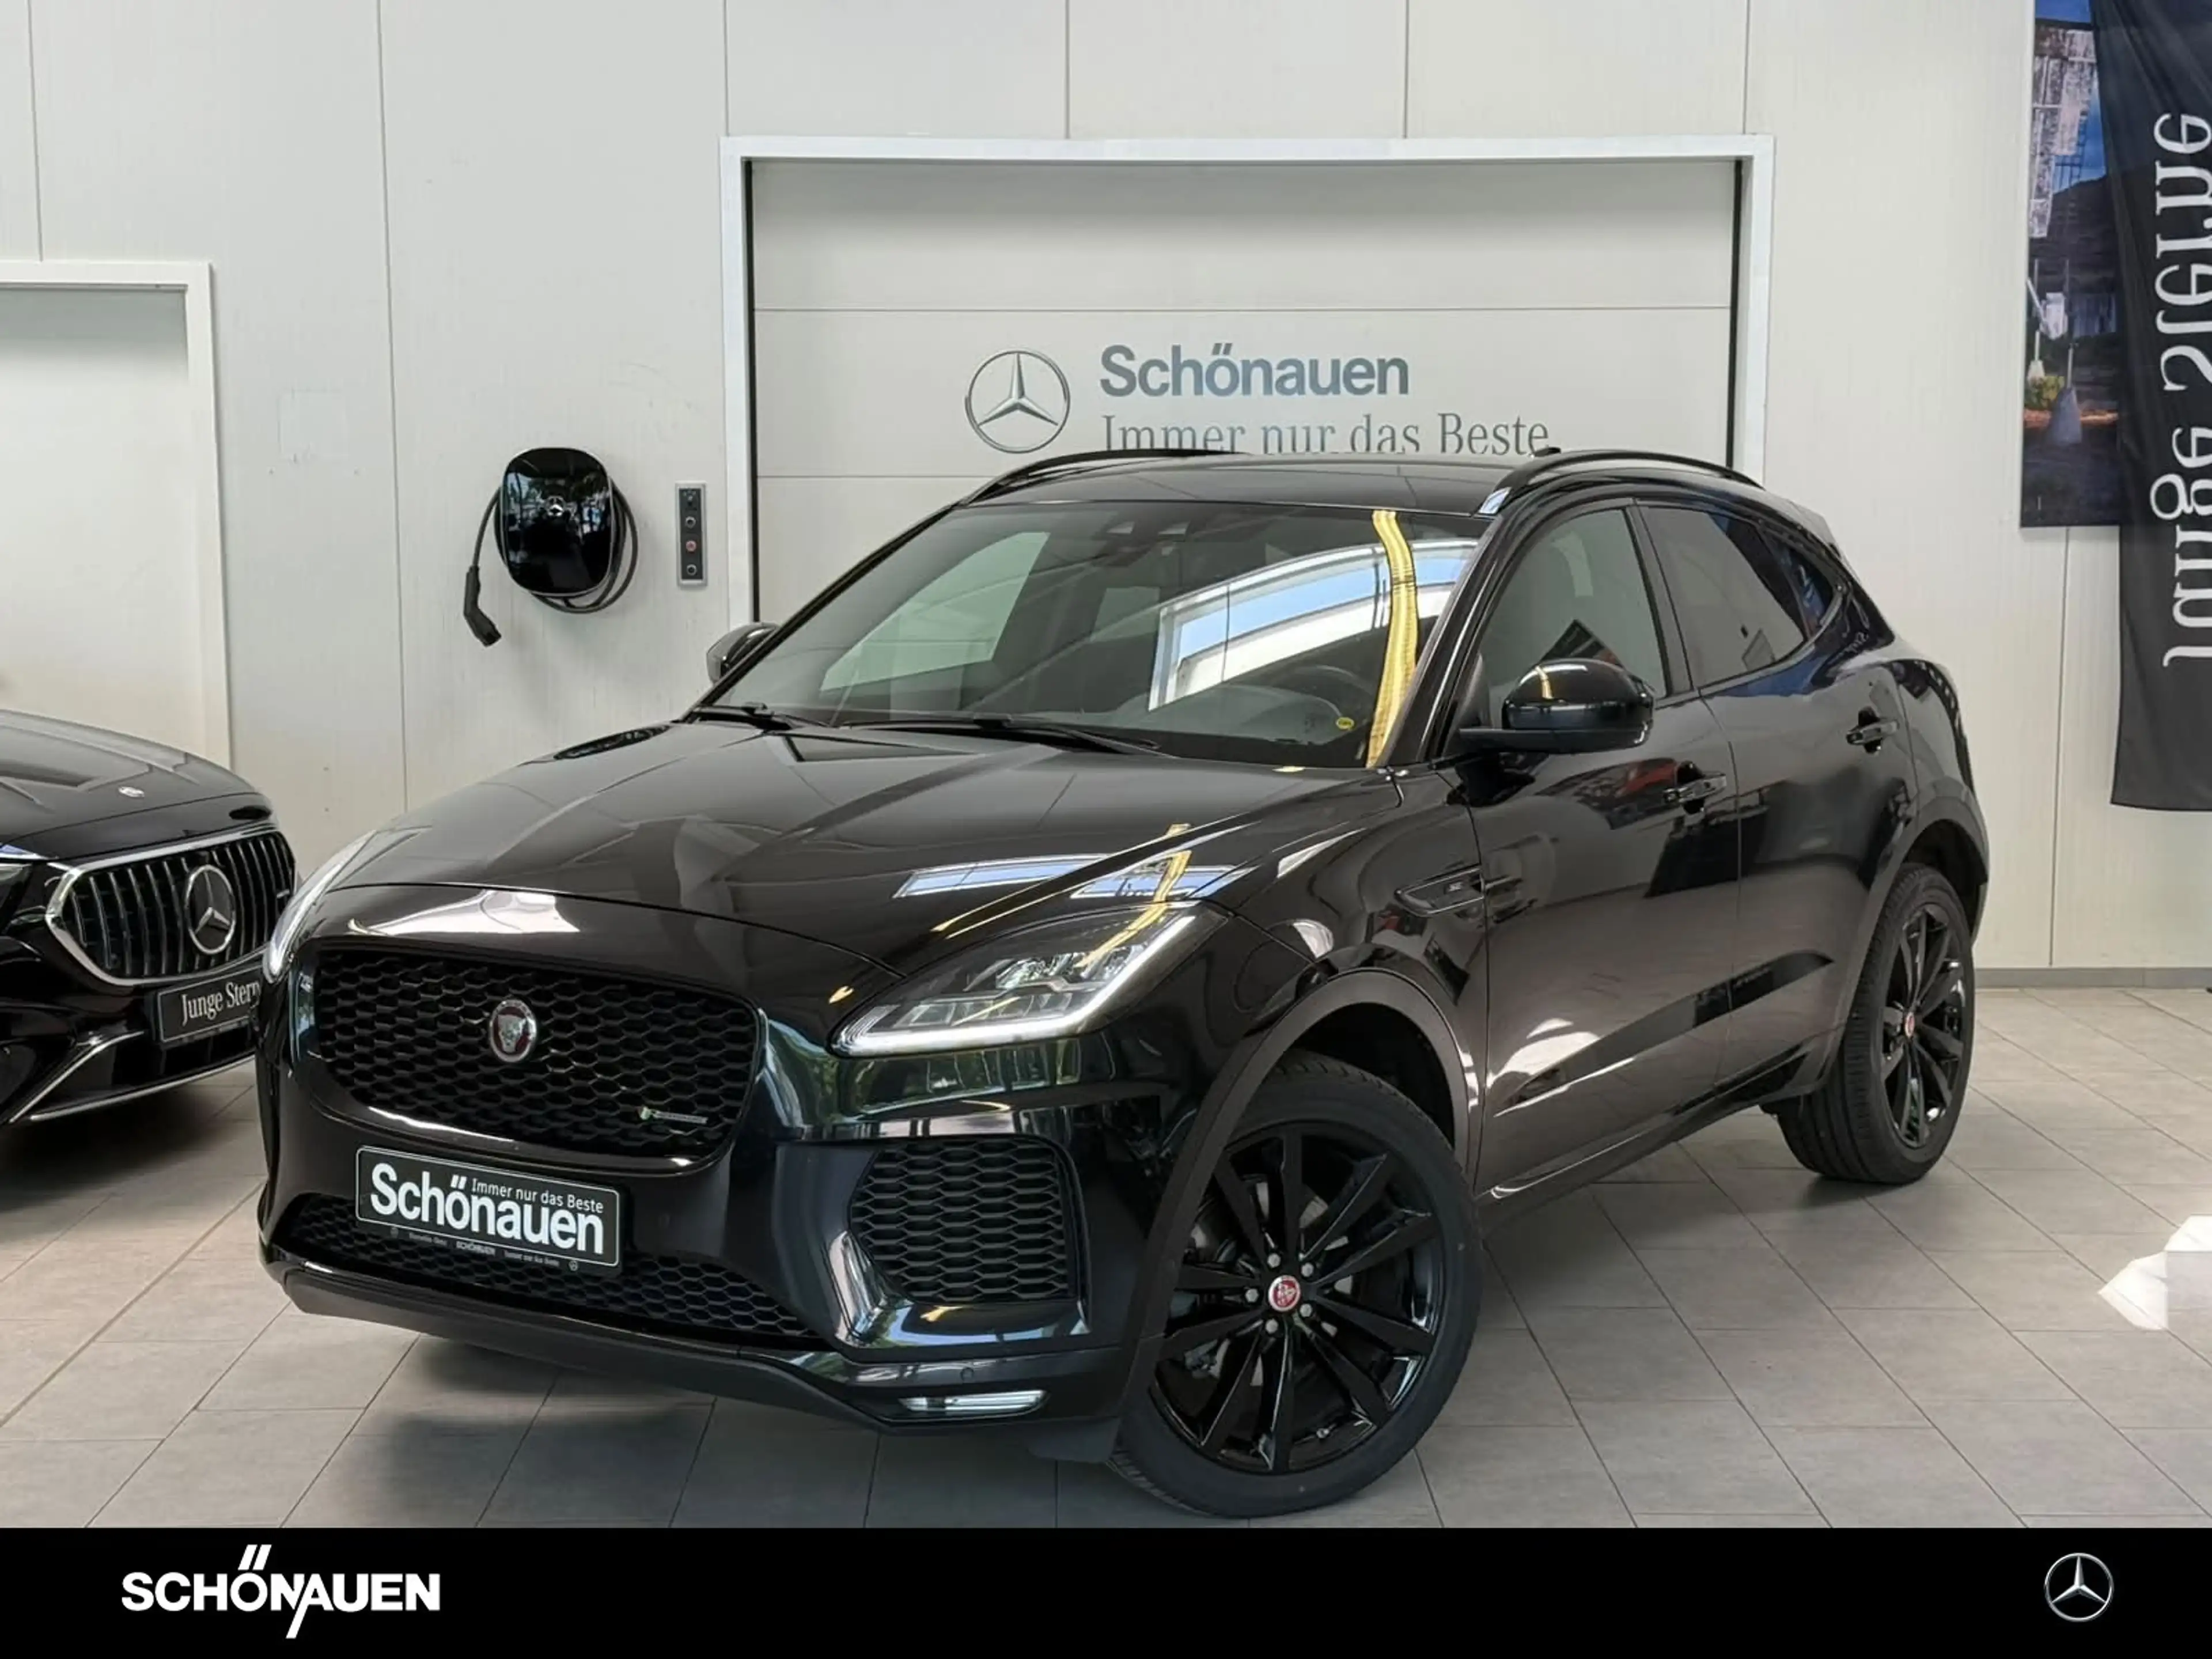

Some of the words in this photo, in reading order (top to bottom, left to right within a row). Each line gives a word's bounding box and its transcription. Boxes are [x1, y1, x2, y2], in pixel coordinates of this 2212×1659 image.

[1100, 342, 1408, 397] Schönauen
[1101, 414, 1246, 454] Immer
[1260, 425, 1336, 454] nur
[1350, 413, 1419, 454] das
[1438, 412, 1549, 456] Beste
[181, 991, 224, 1027] Junge
[370, 1163, 604, 1254] Schönauen
[471, 1178, 512, 1198] Immer
[516, 1187, 538, 1202] nur
[541, 1190, 564, 1207] das
[567, 1194, 604, 1213] Beste
